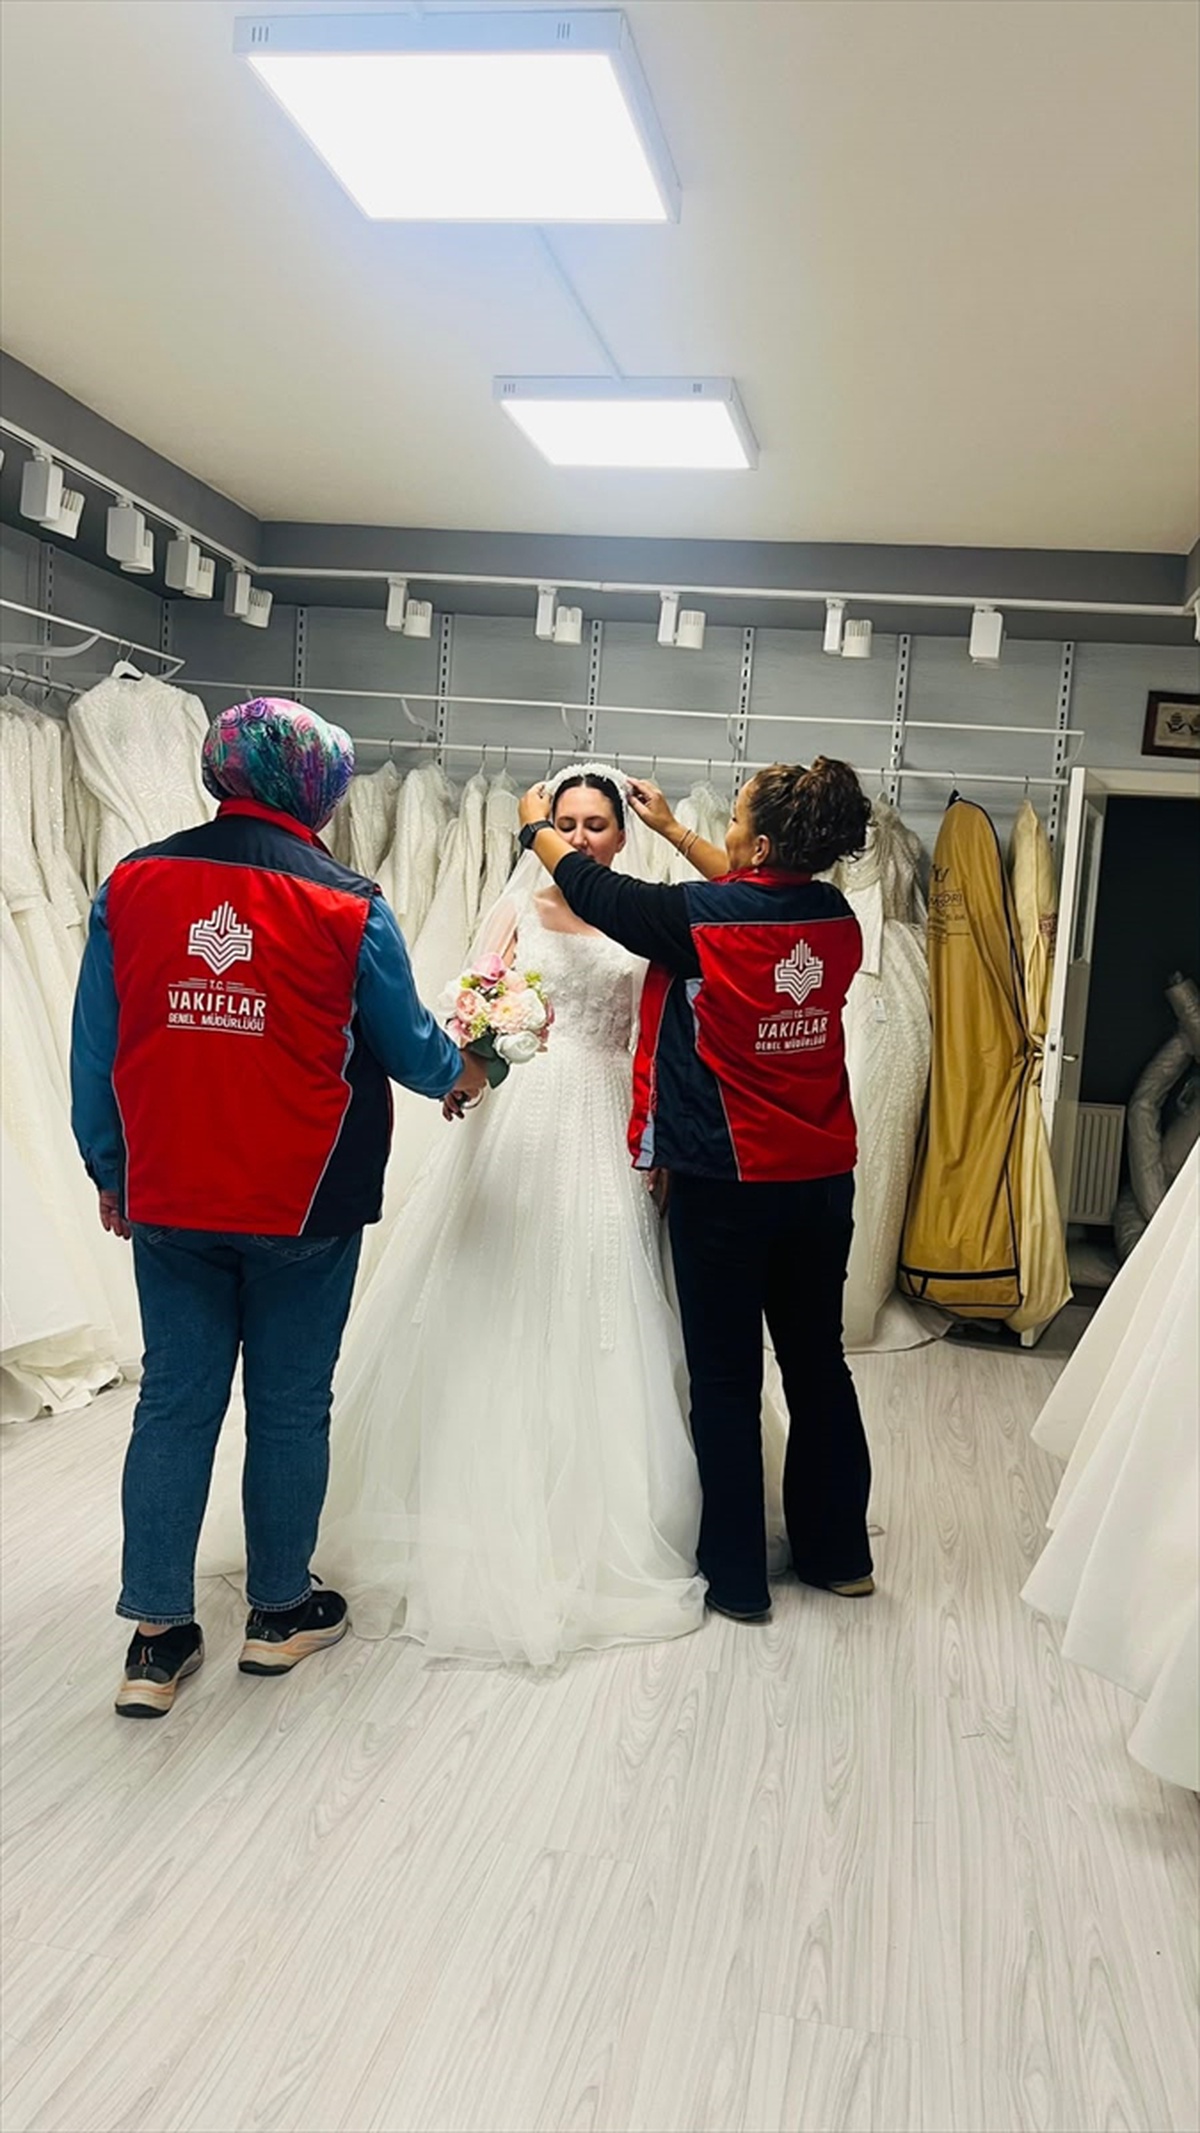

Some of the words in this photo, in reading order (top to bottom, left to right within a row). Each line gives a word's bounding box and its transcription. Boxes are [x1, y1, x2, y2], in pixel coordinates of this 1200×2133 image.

[168, 990, 266, 1017] VAKIFLAR
[168, 1012, 196, 1024] GENEL
[201, 1013, 265, 1031] MÜDÜRLÜĞÜ
[758, 1017, 828, 1038] VAKIFLAR
